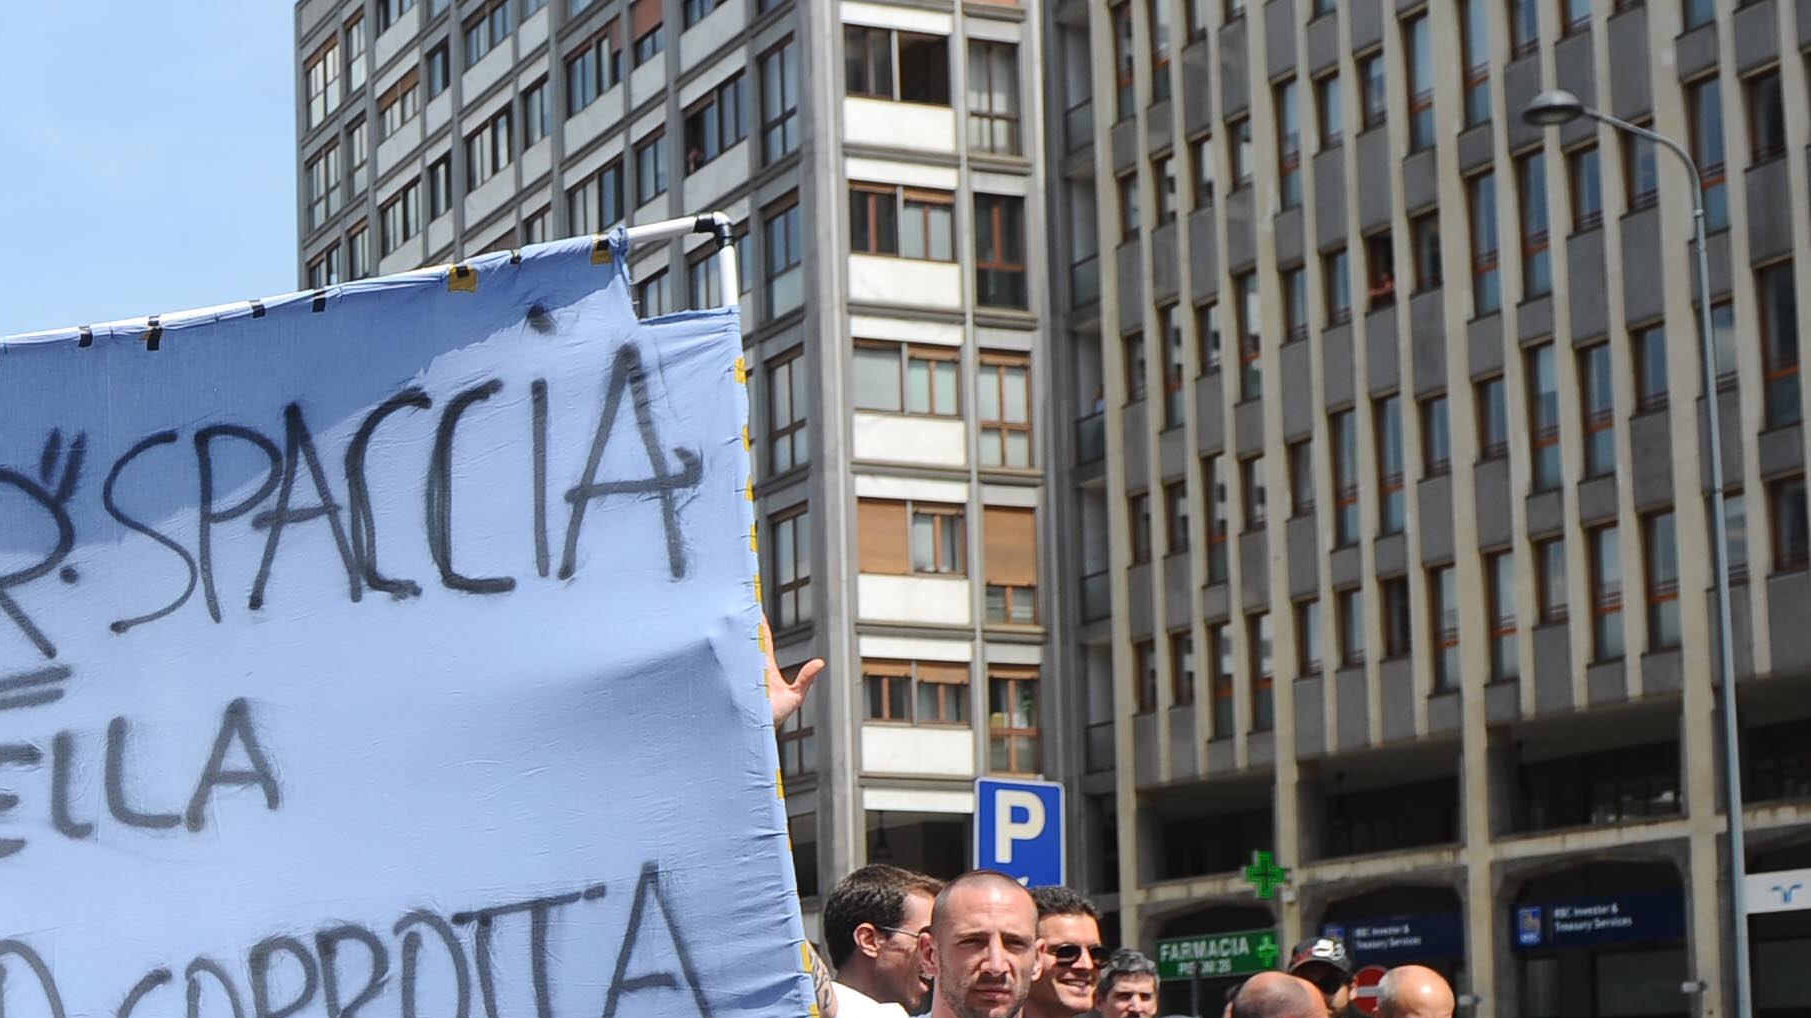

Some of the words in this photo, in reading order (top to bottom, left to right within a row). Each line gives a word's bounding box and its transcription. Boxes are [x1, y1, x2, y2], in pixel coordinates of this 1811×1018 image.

[102, 303, 704, 634] SPACCIA
[994, 788, 1046, 864] P
[1159, 936, 1250, 962] FARMACIA
